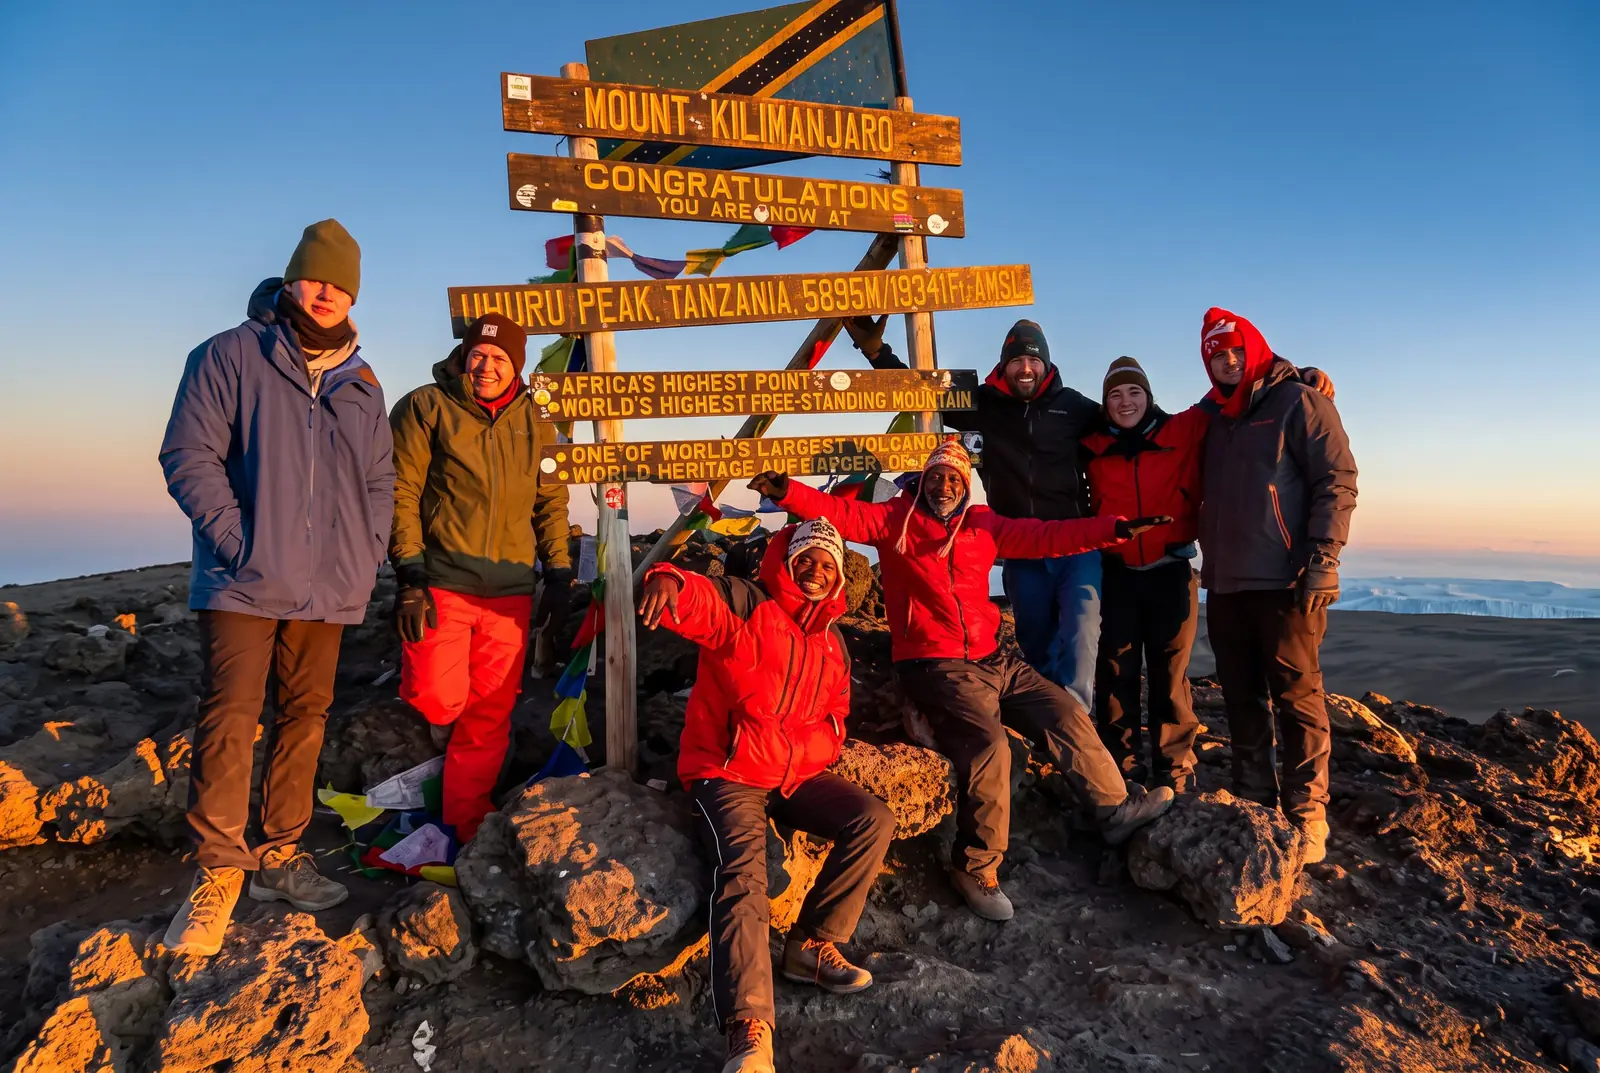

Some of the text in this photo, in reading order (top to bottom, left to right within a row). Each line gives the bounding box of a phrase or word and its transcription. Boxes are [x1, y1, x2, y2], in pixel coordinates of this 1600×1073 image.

[585, 87, 893, 152] MOUNT KILIMANJARO
[584, 163, 908, 212] CONGRATULATIONS
[656, 196, 852, 227] YOU ARE NOW AT
[577, 286, 660, 323] PEAK,
[665, 280, 798, 320] TANZANIA,
[562, 374, 656, 395] AFRICA'S
[662, 372, 748, 393] HIGHEST
[755, 371, 810, 391] POINT
[561, 395, 653, 418] WORLD'S
[660, 393, 746, 415] HIGHEST
[750, 390, 887, 413] FREE-STANDING
[892, 389, 972, 409] MOUNTAIN
[571, 432, 962, 464] ONE OF WORLD'S LARGEST VOLCANO
[572, 464, 651, 484] WORLD
[658, 459, 755, 480] HERITAGE
